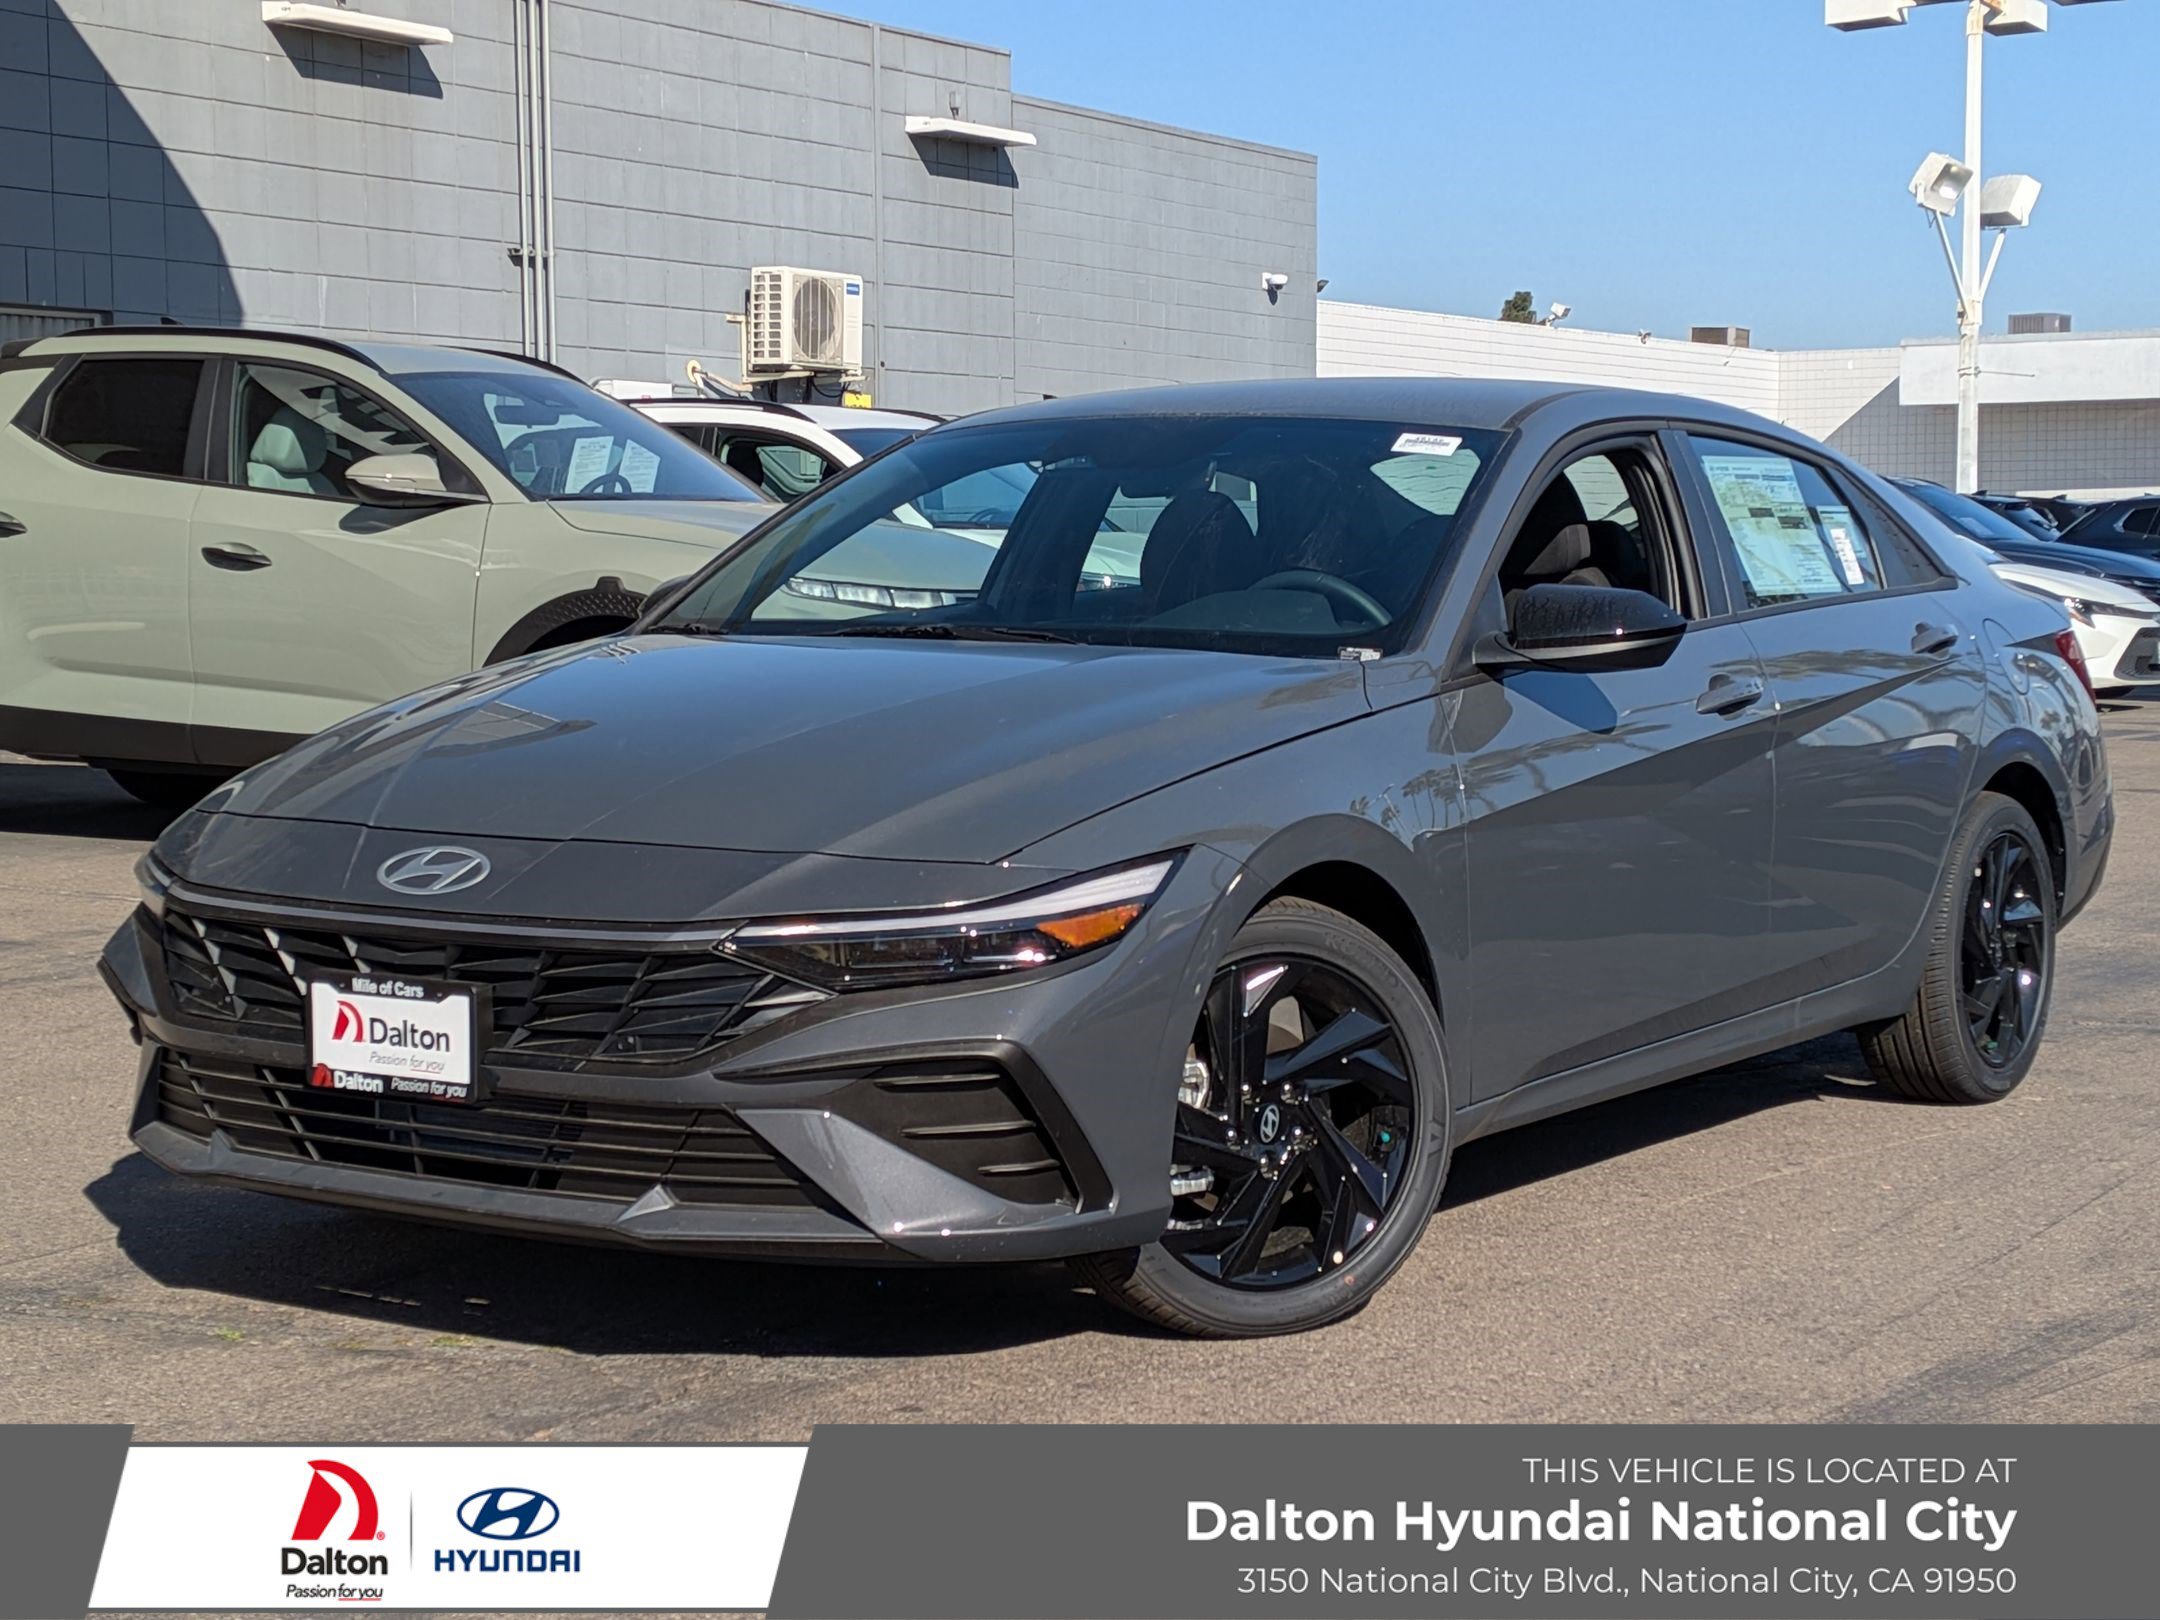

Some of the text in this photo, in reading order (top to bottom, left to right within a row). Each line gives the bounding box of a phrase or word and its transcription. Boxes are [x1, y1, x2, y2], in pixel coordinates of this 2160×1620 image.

[352, 977, 424, 998] Mile of Cars
[369, 1017, 450, 1052] Dalton
[369, 1051, 446, 1072] Passion for you
[333, 1070, 467, 1098] Dalton Passion for you
